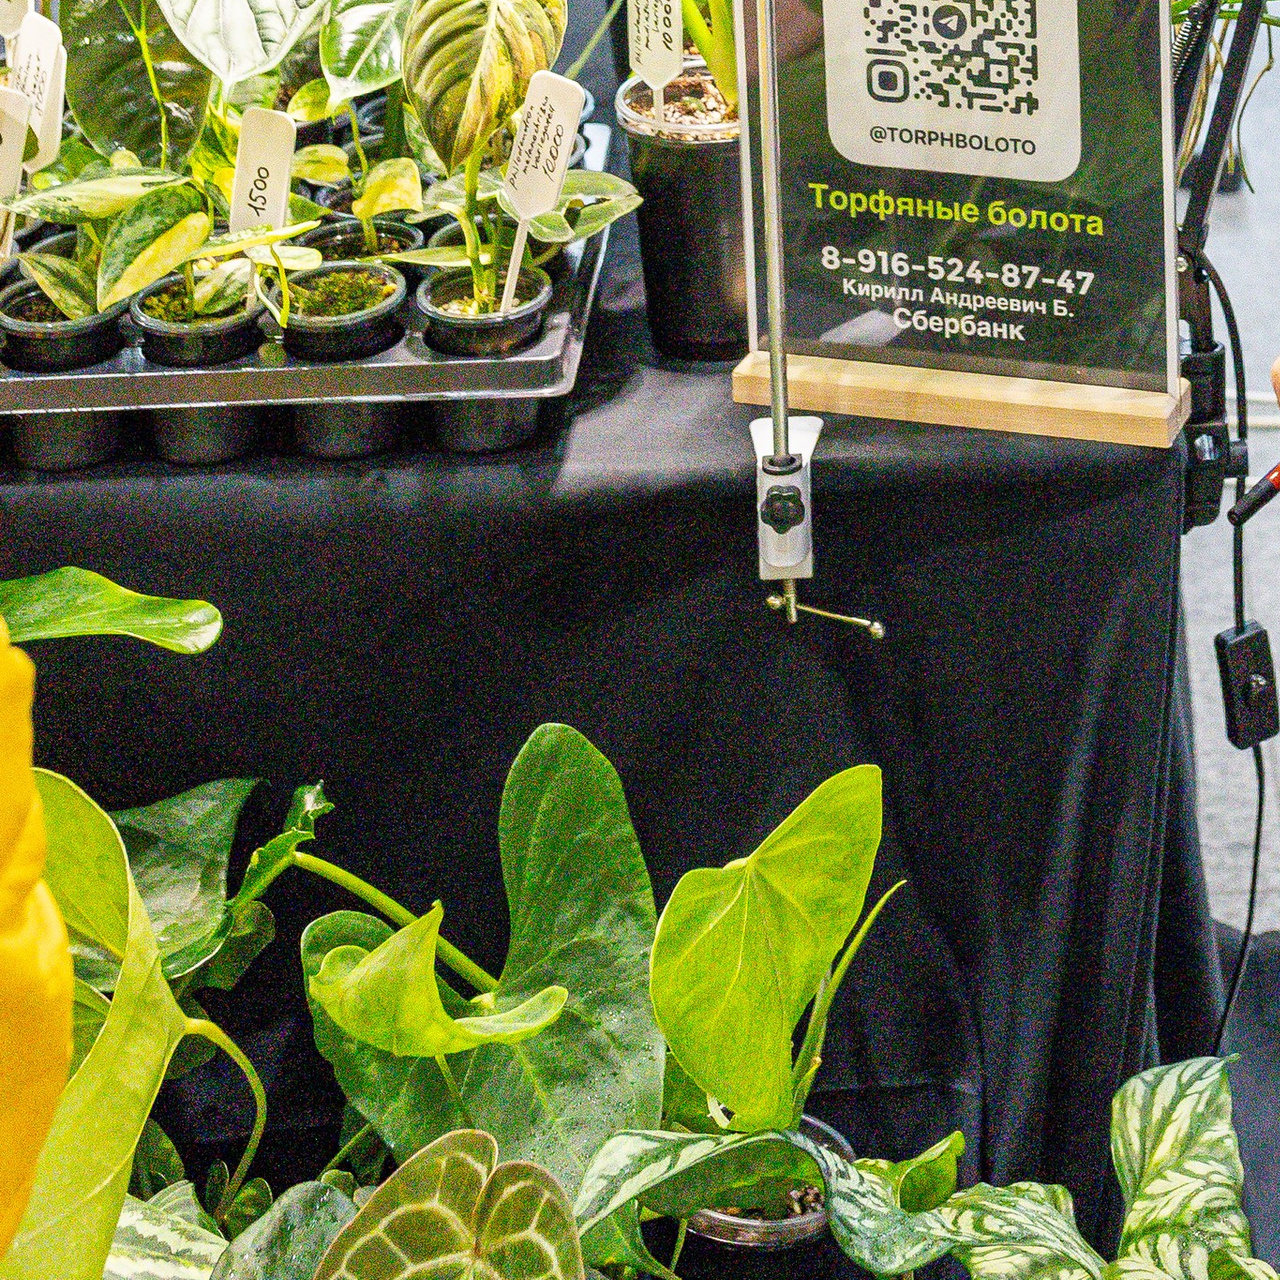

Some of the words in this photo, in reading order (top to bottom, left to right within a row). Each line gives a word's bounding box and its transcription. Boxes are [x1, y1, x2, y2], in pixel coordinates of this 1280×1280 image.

[542, 124, 564, 182] 10000
[870, 125, 1036, 156] @TORPHBOLOTO
[247, 166, 270, 217] 1500
[808, 182, 979, 223] Торфяные
[988, 200, 1104, 236] болота
[821, 245, 1095, 296] 8-916-524-87-47
[842, 278, 923, 302] Кирилл
[930, 286, 1047, 316] Андреевич
[1053, 300, 1075, 318] Б.
[893, 307, 1026, 342] Сбербанк
